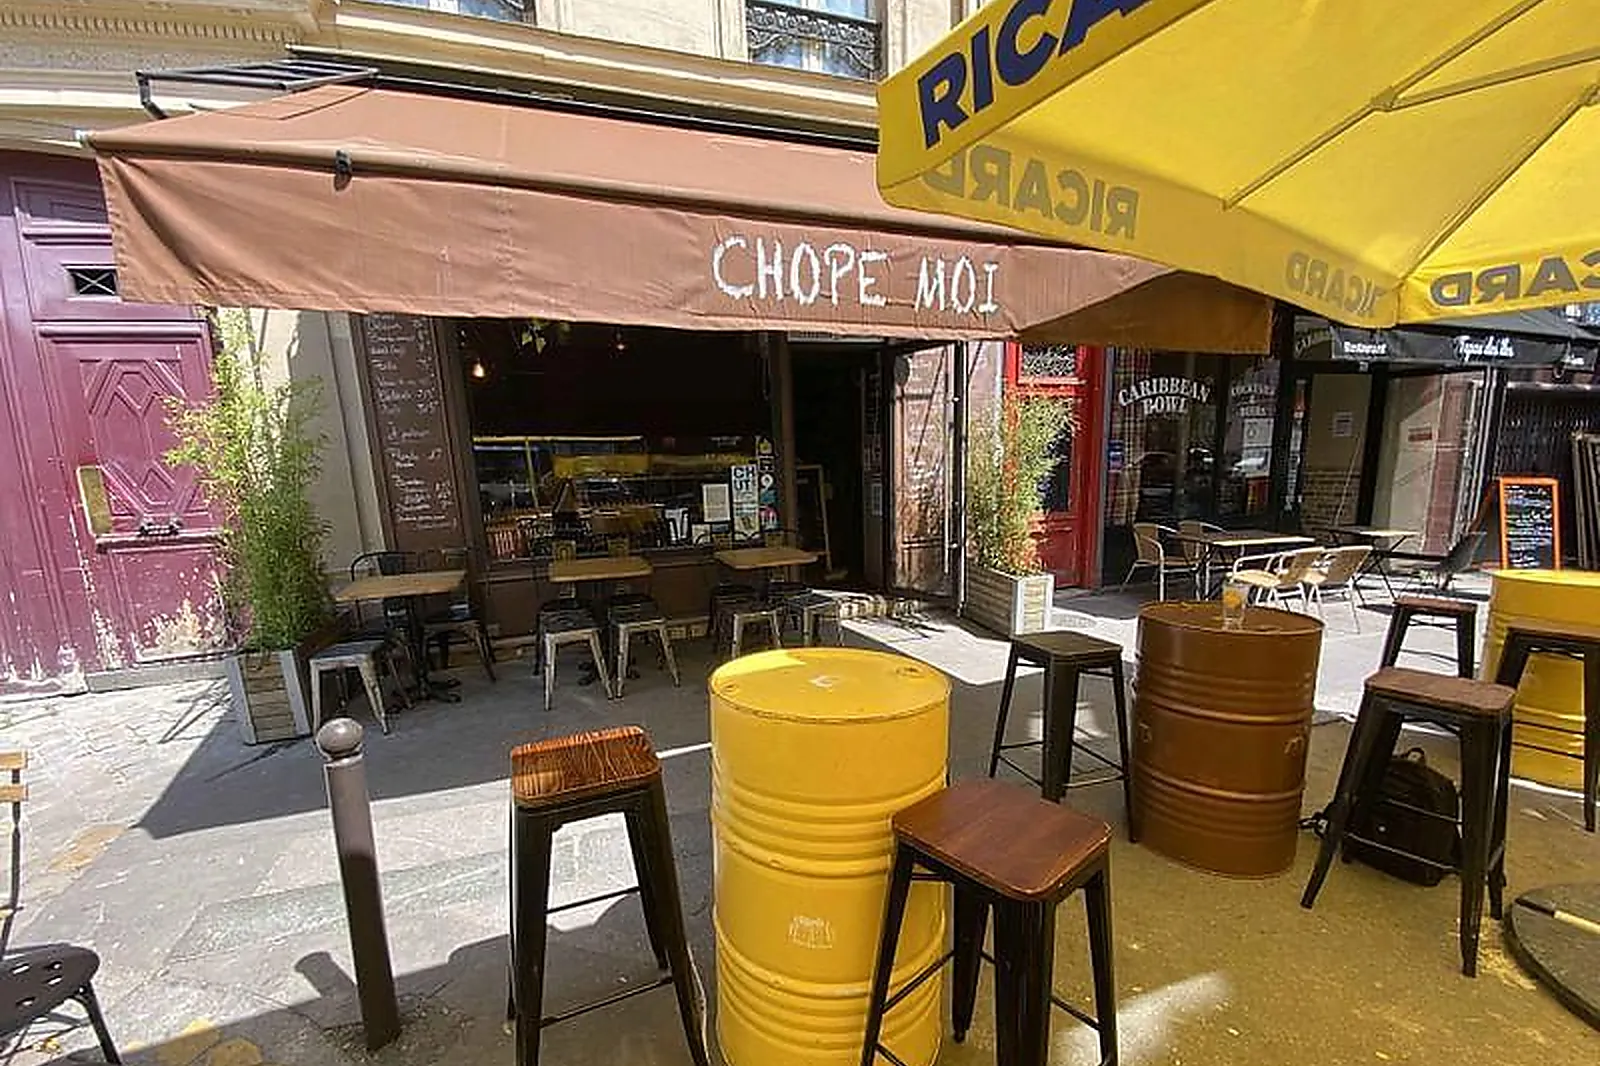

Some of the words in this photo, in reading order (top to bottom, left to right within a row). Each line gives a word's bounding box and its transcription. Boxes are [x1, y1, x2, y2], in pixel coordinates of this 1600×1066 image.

[712, 236, 888, 306] CHOPE
[914, 255, 999, 313] MOI
[1118, 377, 1211, 406] CARIBBEAN
[1141, 396, 1188, 414] BOWL
